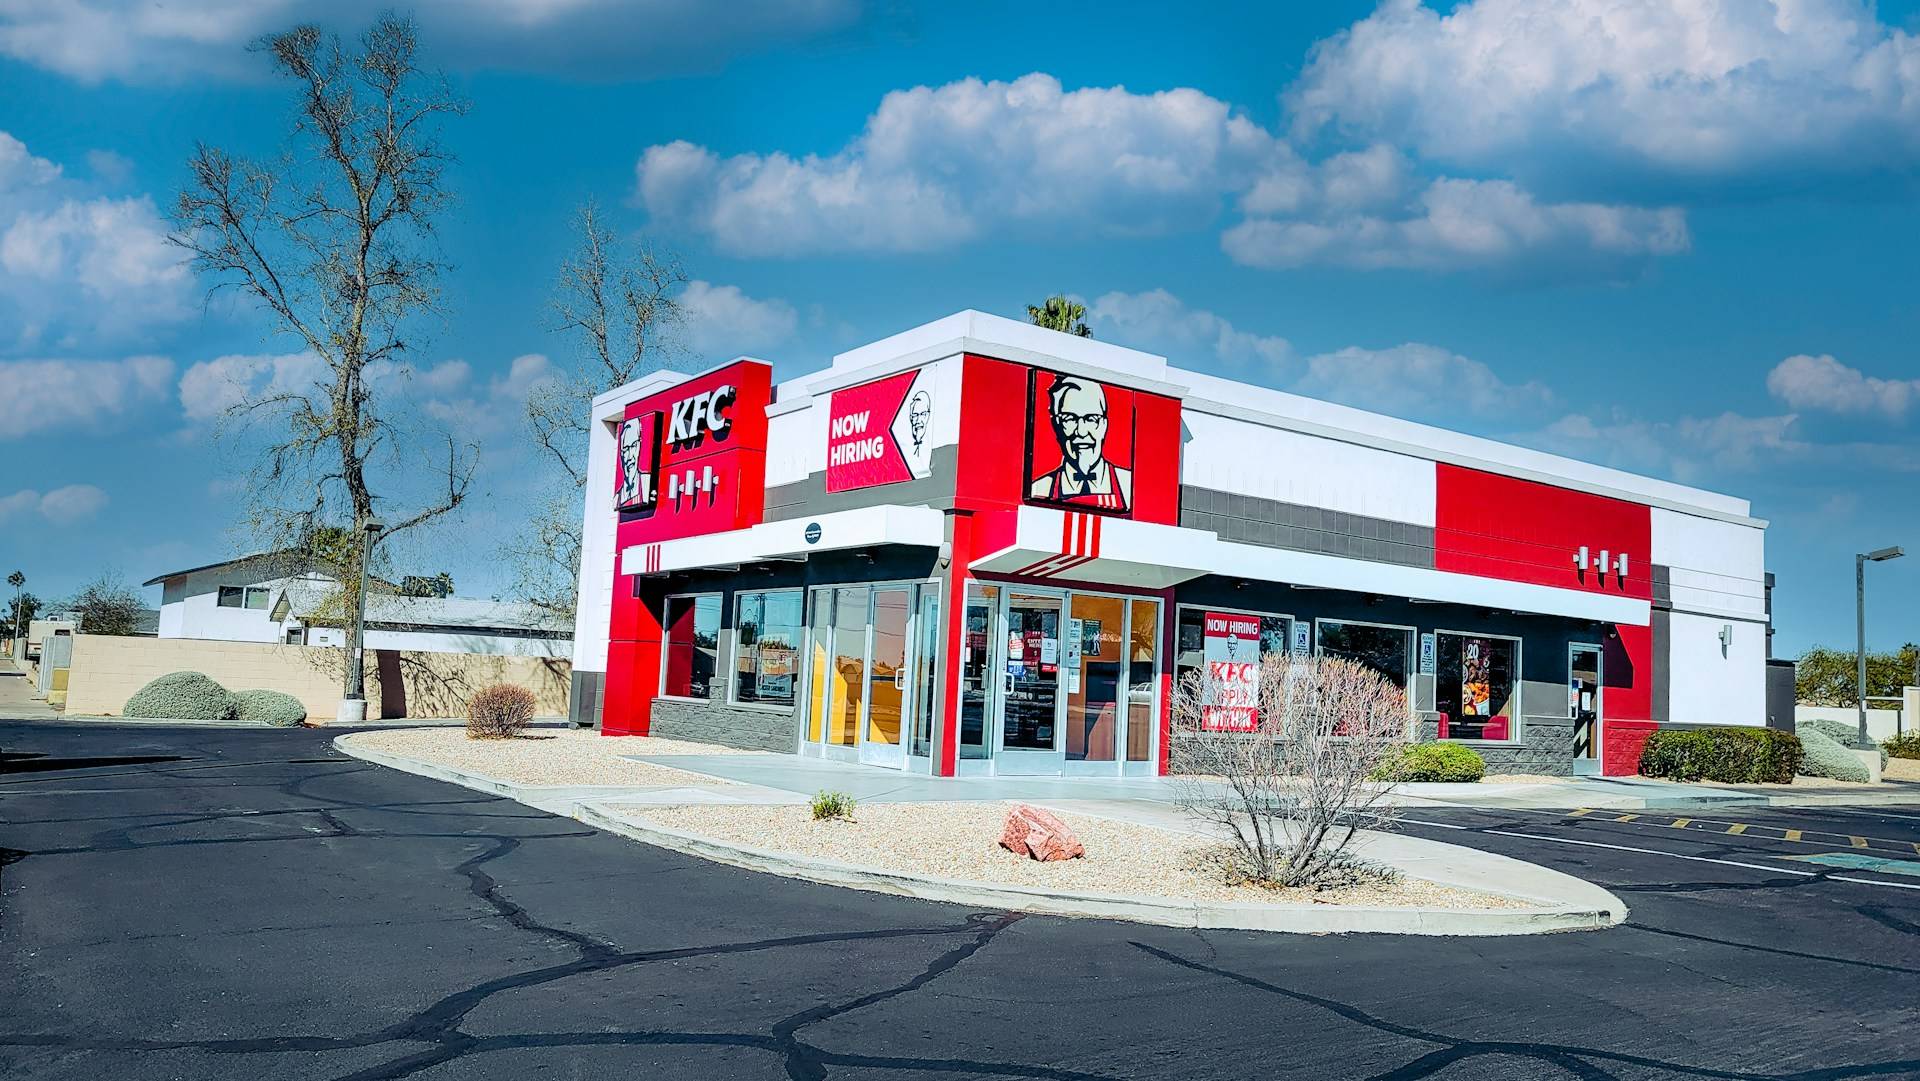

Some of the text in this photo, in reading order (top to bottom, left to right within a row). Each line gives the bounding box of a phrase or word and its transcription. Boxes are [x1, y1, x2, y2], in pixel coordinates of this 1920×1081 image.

[666, 384, 730, 444] KFC
[831, 410, 870, 440] NOW
[830, 436, 884, 467] HIRING
[1207, 619, 1258, 635] NOW HIRING
[1209, 661, 1253, 685] KFC
